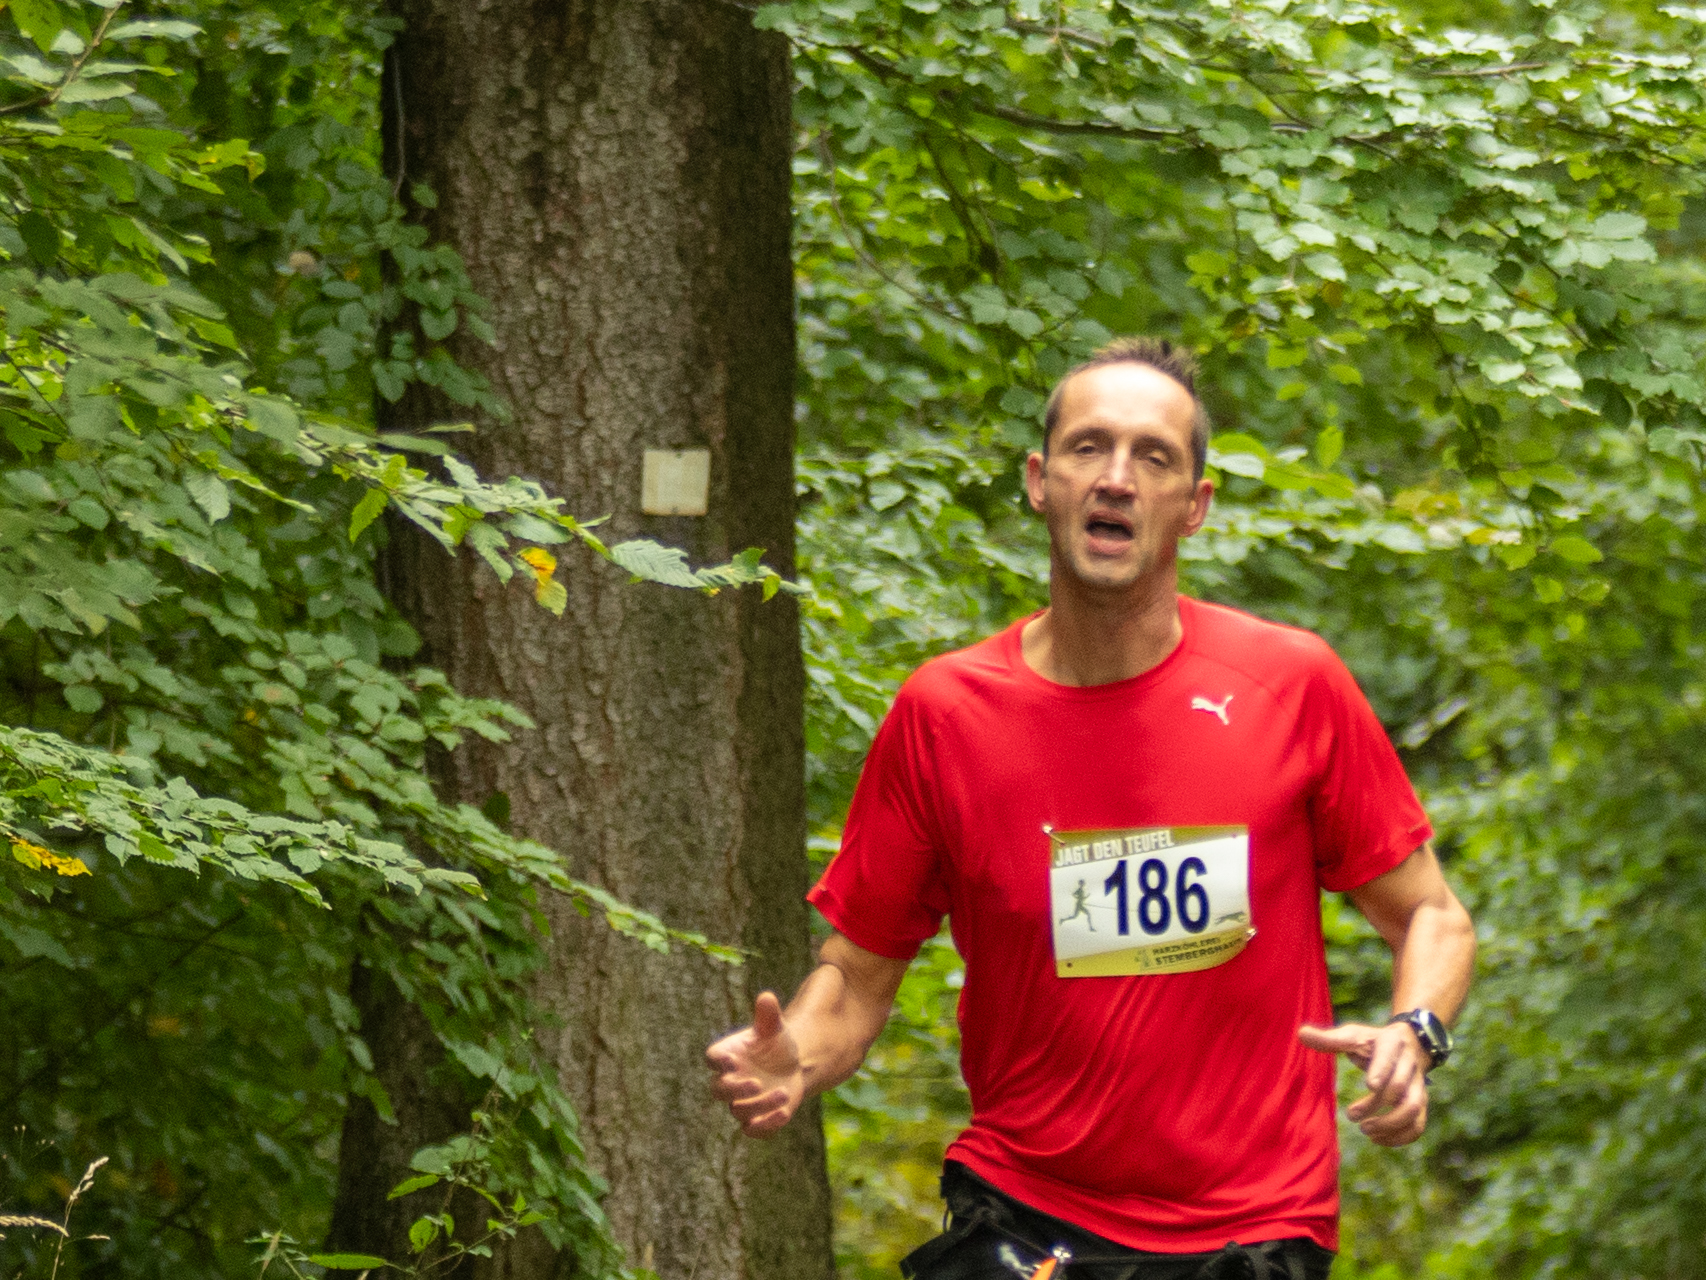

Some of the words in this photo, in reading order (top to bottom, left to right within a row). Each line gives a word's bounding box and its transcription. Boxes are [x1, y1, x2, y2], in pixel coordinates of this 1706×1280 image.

[1055, 844, 1090, 867] JAGT
[1092, 838, 1124, 860] DEN
[1124, 829, 1175, 855] TEUFEL
[1103, 855, 1211, 937] 186
